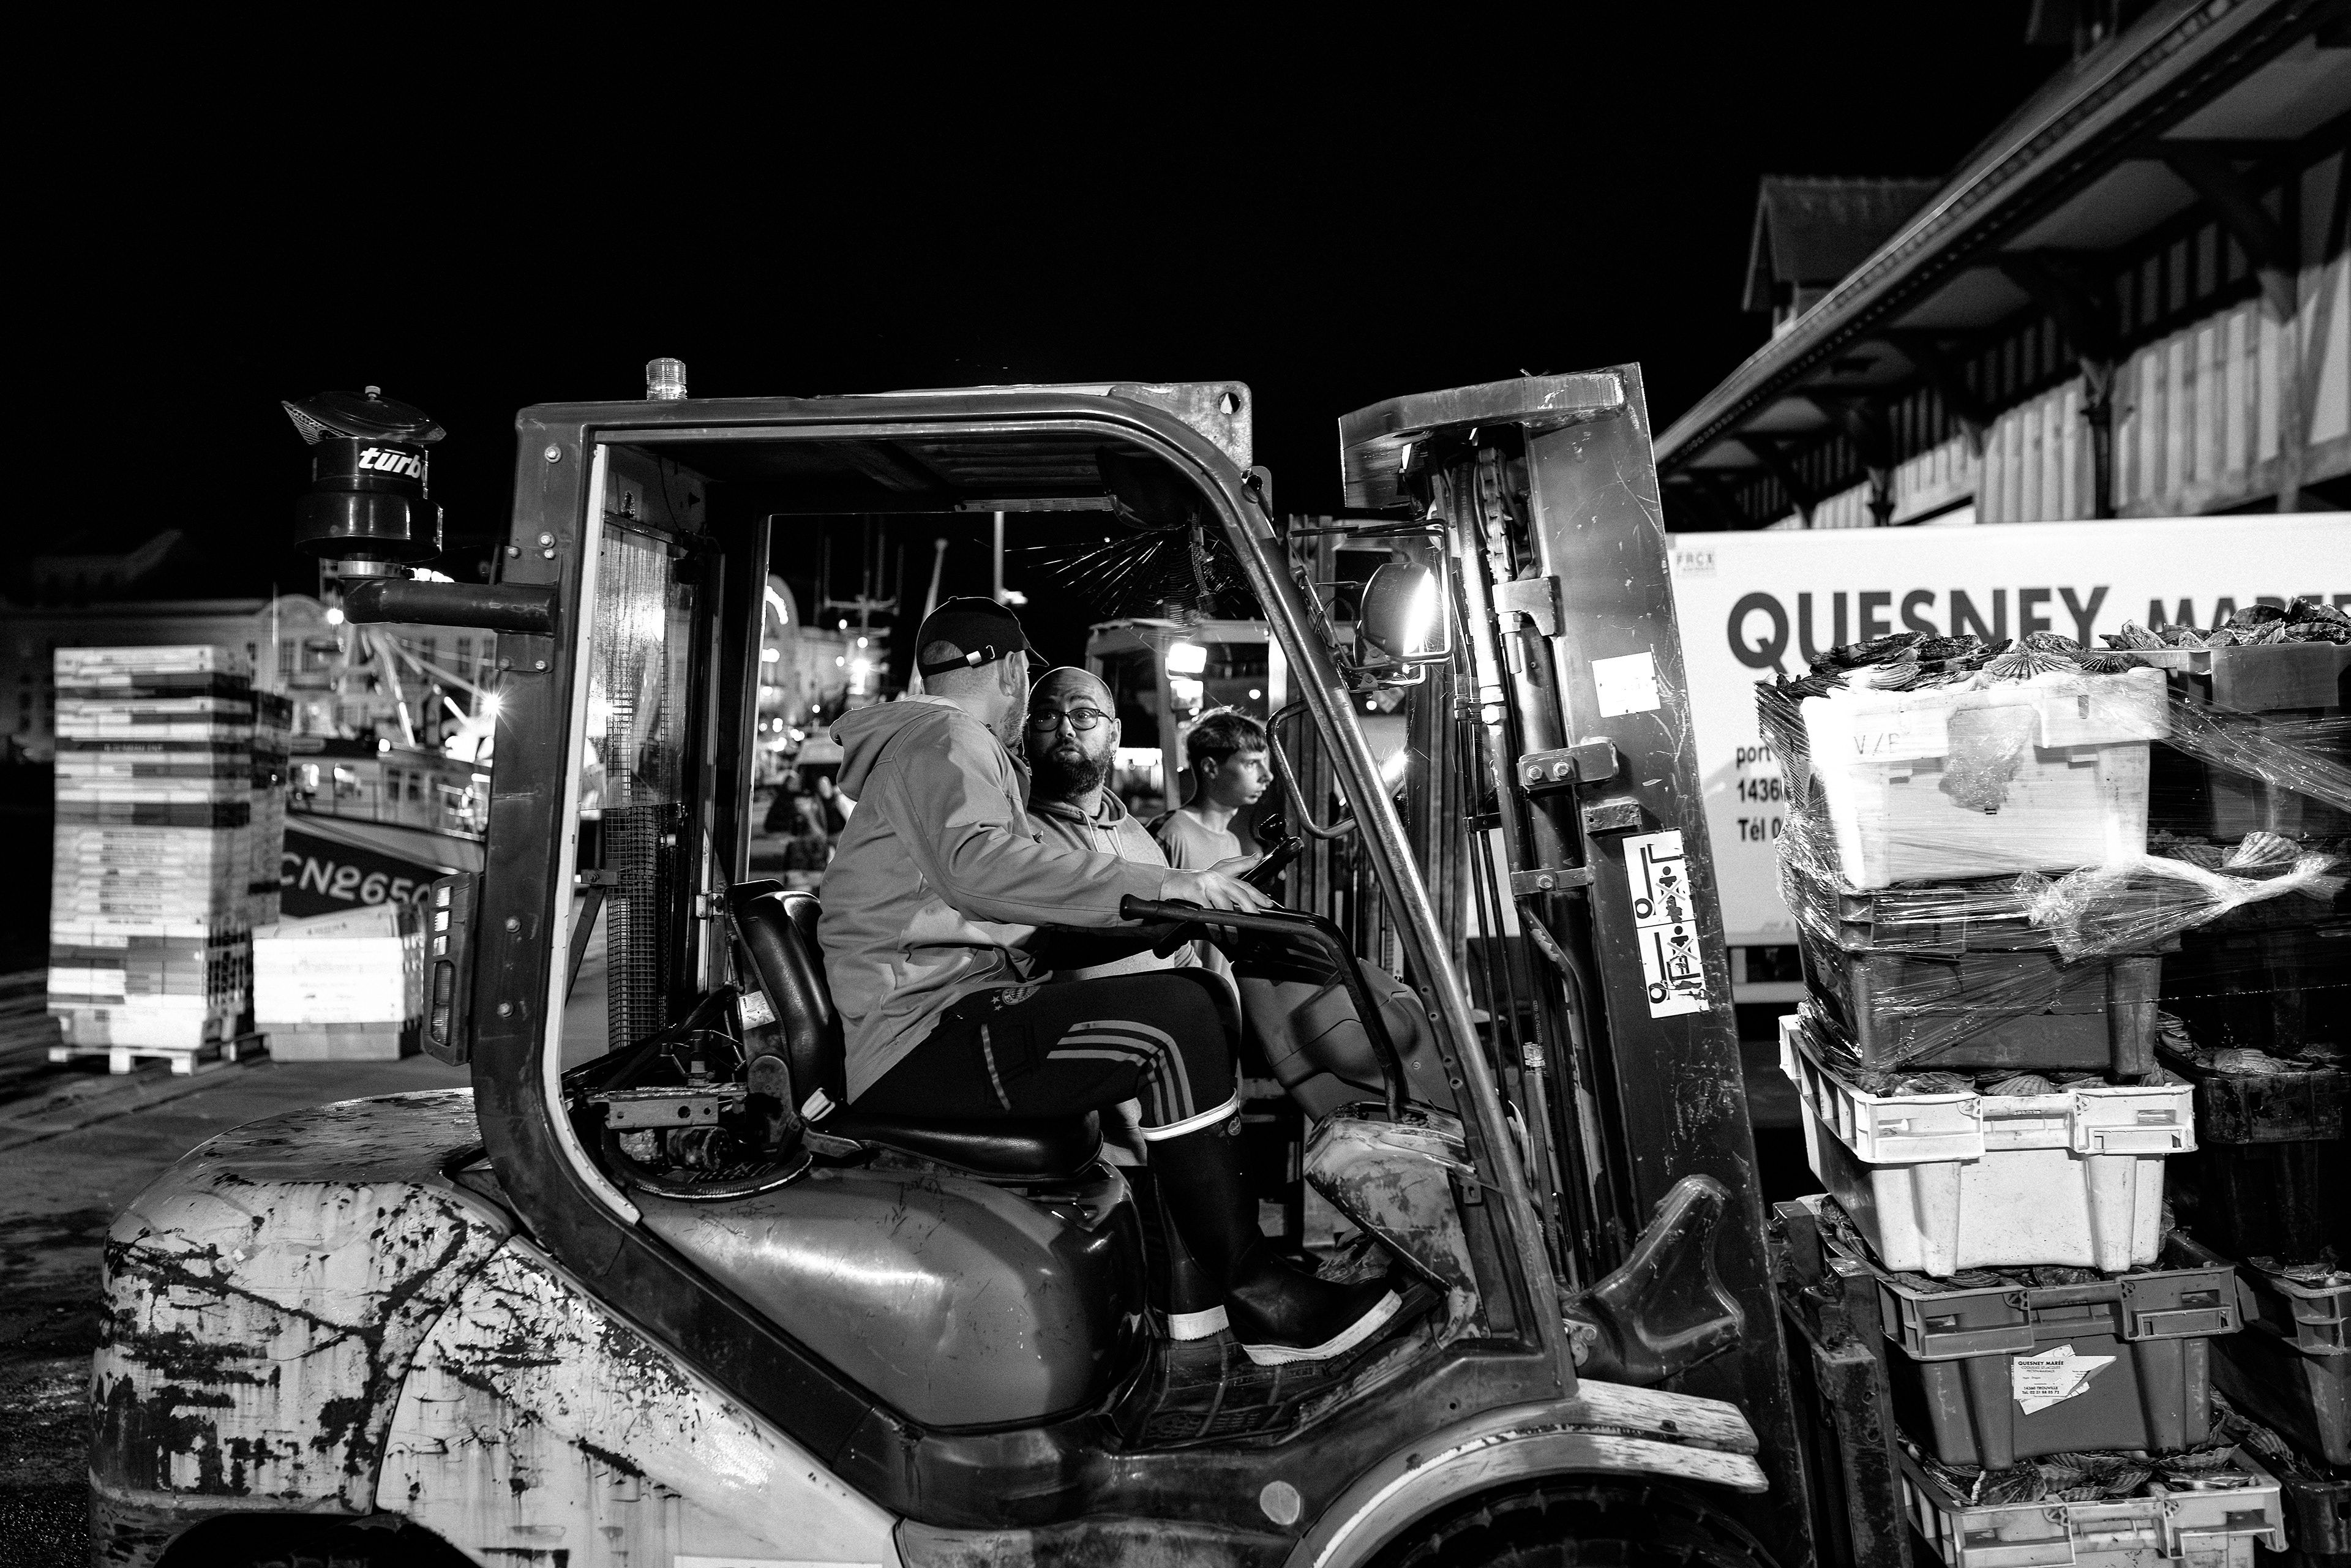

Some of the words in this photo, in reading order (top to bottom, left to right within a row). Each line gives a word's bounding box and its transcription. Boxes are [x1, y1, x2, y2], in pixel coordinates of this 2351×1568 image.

[1727, 585, 2110, 674] QUESNEY
[1737, 778, 1785, 803] 1436
[1737, 816, 1766, 842] Tél
